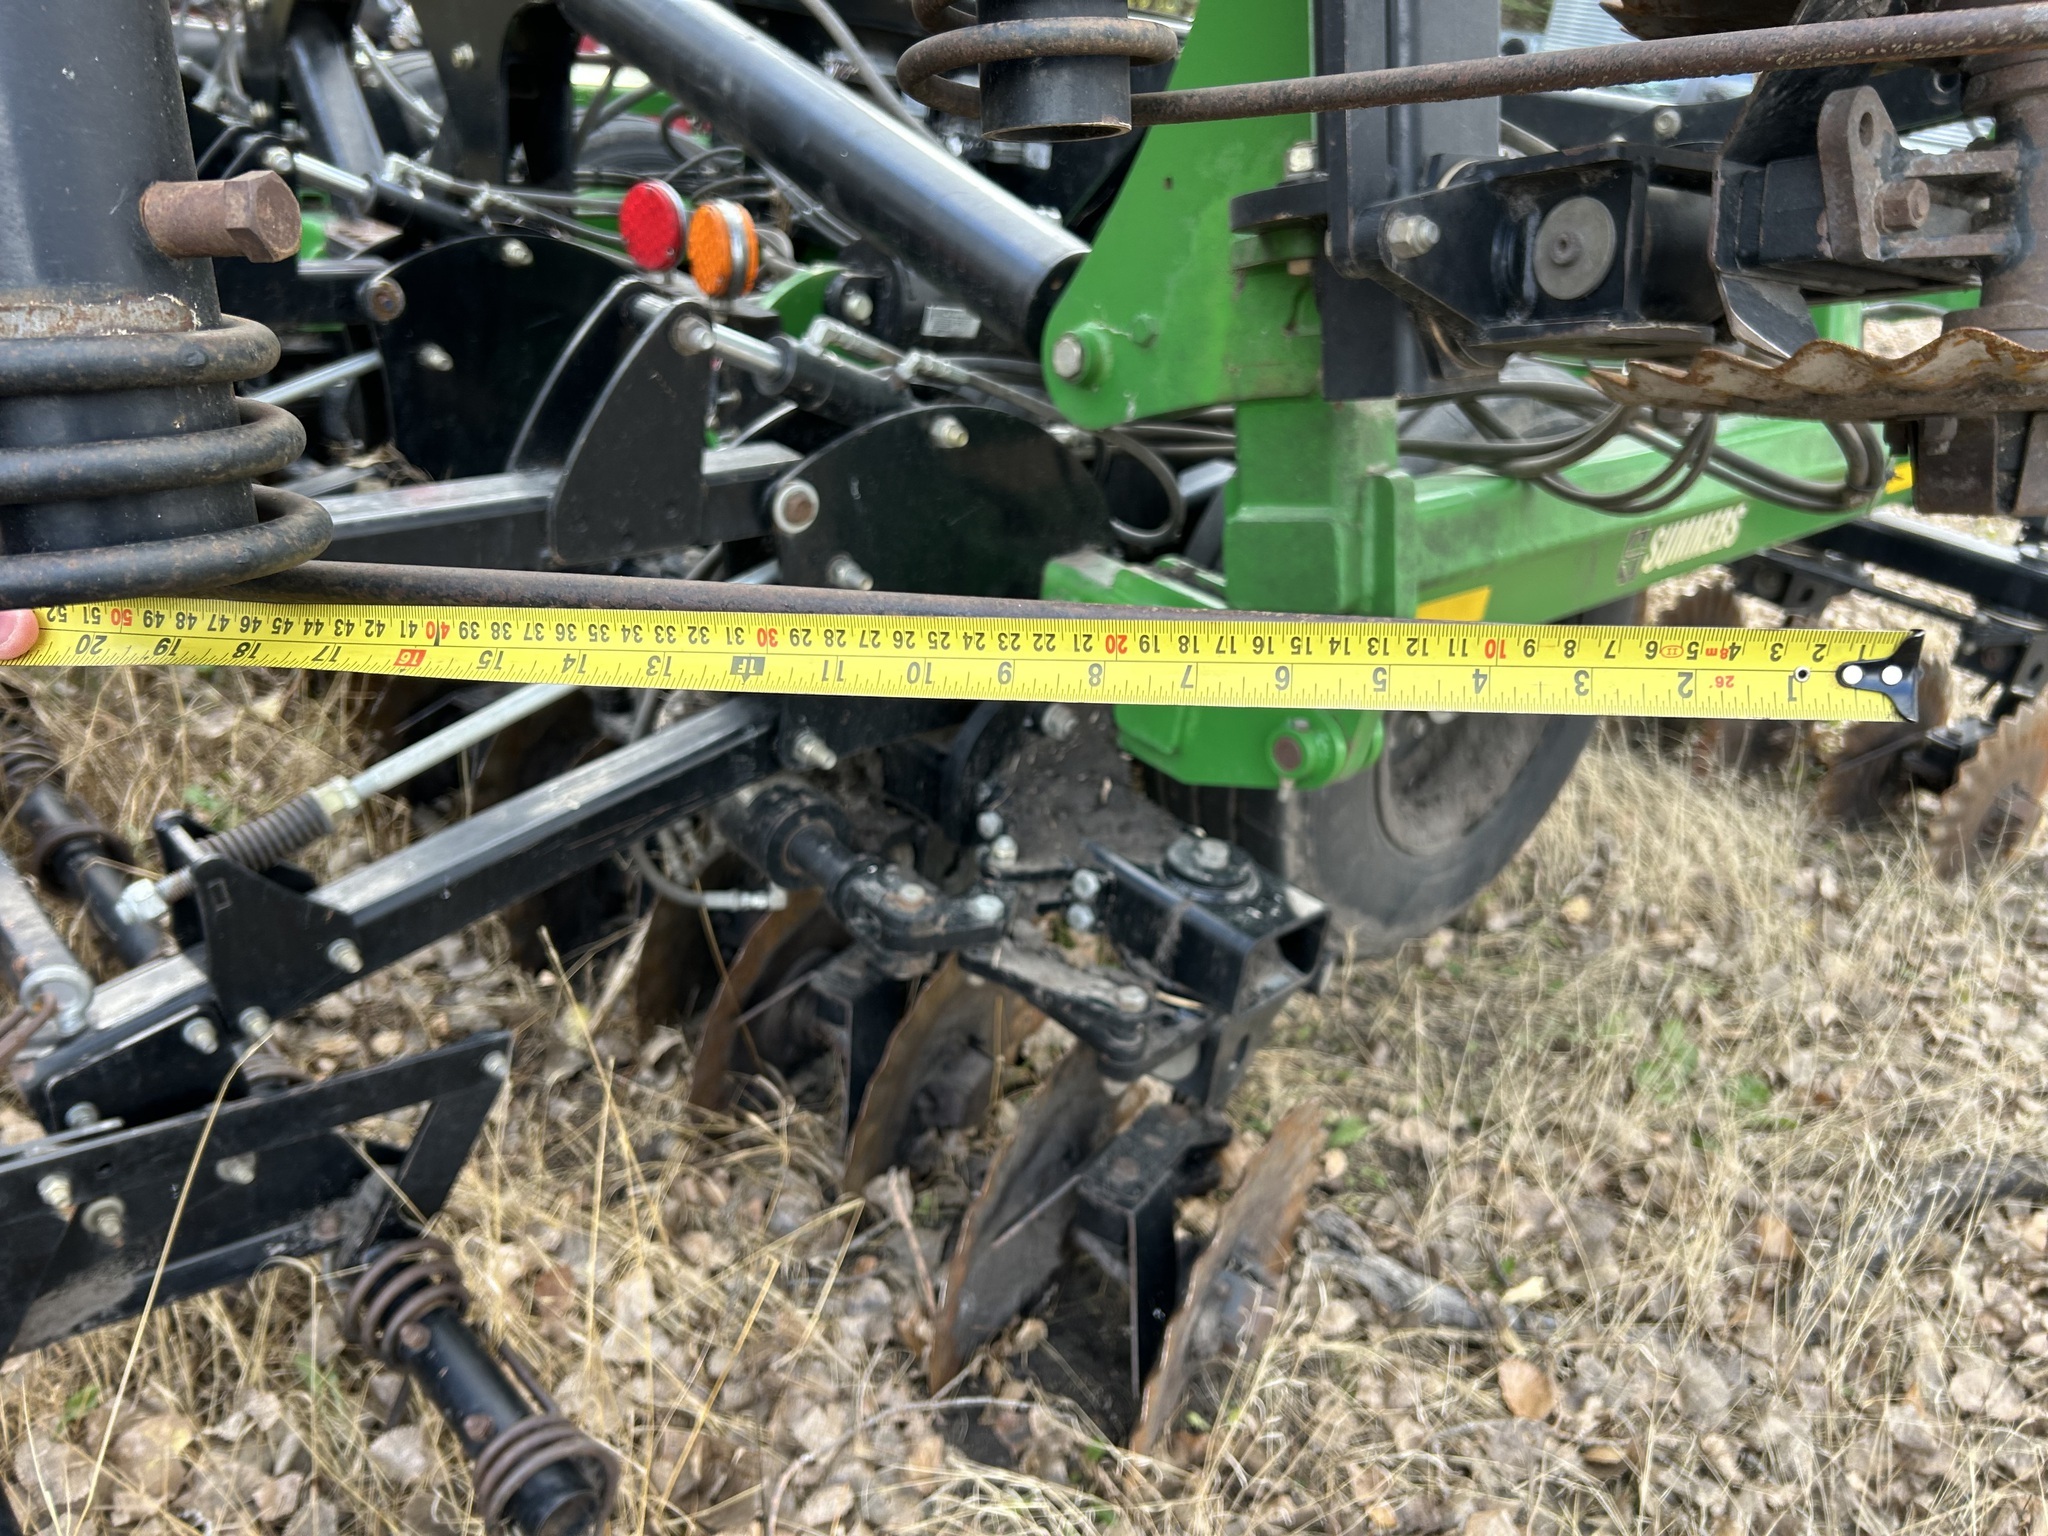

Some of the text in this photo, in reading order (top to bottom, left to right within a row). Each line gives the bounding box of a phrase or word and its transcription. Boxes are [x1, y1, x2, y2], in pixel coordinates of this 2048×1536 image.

[1641, 502, 1747, 574] SUMMERS
[46, 604, 68, 623] 52
[83, 606, 101, 625] 51
[110, 608, 133, 627] 50
[143, 609, 165, 628] 49
[175, 611, 198, 630] 48
[207, 613, 230, 632] 47
[239, 615, 262, 634] 46
[271, 617, 294, 635] 45
[303, 618, 324, 636] 44
[334, 619, 355, 637] 43
[365, 619, 386, 638] 42
[400, 620, 418, 638] 41
[425, 620, 450, 640] 40
[459, 621, 480, 640] 39
[491, 621, 512, 641] 38
[523, 622, 544, 641] 37
[555, 623, 577, 642] 36
[588, 623, 610, 643] 35
[621, 624, 643, 643] 34
[654, 625, 676, 644] 33
[687, 625, 710, 645] 32
[726, 626, 745, 646] 31
[757, 627, 779, 648] 30
[789, 628, 812, 647] 29
[823, 628, 847, 648] 28
[859, 629, 881, 649] 27
[893, 630, 916, 650] 26
[927, 631, 951, 650] 25
[963, 631, 986, 651] 24
[997, 632, 1021, 652] 23
[1033, 633, 1056, 652] 22
[1073, 633, 1093, 653] 21
[1105, 634, 1128, 654] 20
[1139, 634, 1160, 654] 19
[75, 634, 108, 655] 20
[153, 637, 182, 657] 19
[232, 641, 262, 659] 18
[312, 645, 342, 663] 17
[1178, 635, 1200, 654] 18
[1215, 635, 1237, 654] 17
[1252, 636, 1275, 655] 16
[1290, 636, 1313, 655] 15
[1329, 637, 1351, 656] 14
[1367, 637, 1390, 656] 13
[1406, 637, 1429, 657] 12
[1448, 638, 1468, 657] 11
[1484, 638, 1506, 659] 10
[1523, 639, 1536, 658] 9
[1563, 639, 1577, 659] 8
[1604, 640, 1616, 659] 7
[1645, 640, 1658, 660] 6
[1687, 641, 1700, 660] 5
[1728, 642, 1741, 661] 4
[1770, 643, 1783, 662] 3
[1812, 644, 1826, 662] 2
[398, 650, 420, 665] 16
[476, 650, 504, 670] 15
[561, 653, 587, 674] 14
[646, 655, 672, 677] 13
[821, 659, 844, 682] 11
[906, 661, 933, 685] 10
[997, 661, 1013, 685] 9
[1088, 663, 1103, 687] 8
[1180, 664, 1194, 689] 7
[1274, 665, 1291, 691] 6
[1372, 667, 1388, 692] 5
[1472, 668, 1488, 695] 4
[1573, 669, 1590, 696] 3
[1677, 672, 1694, 699] 2
